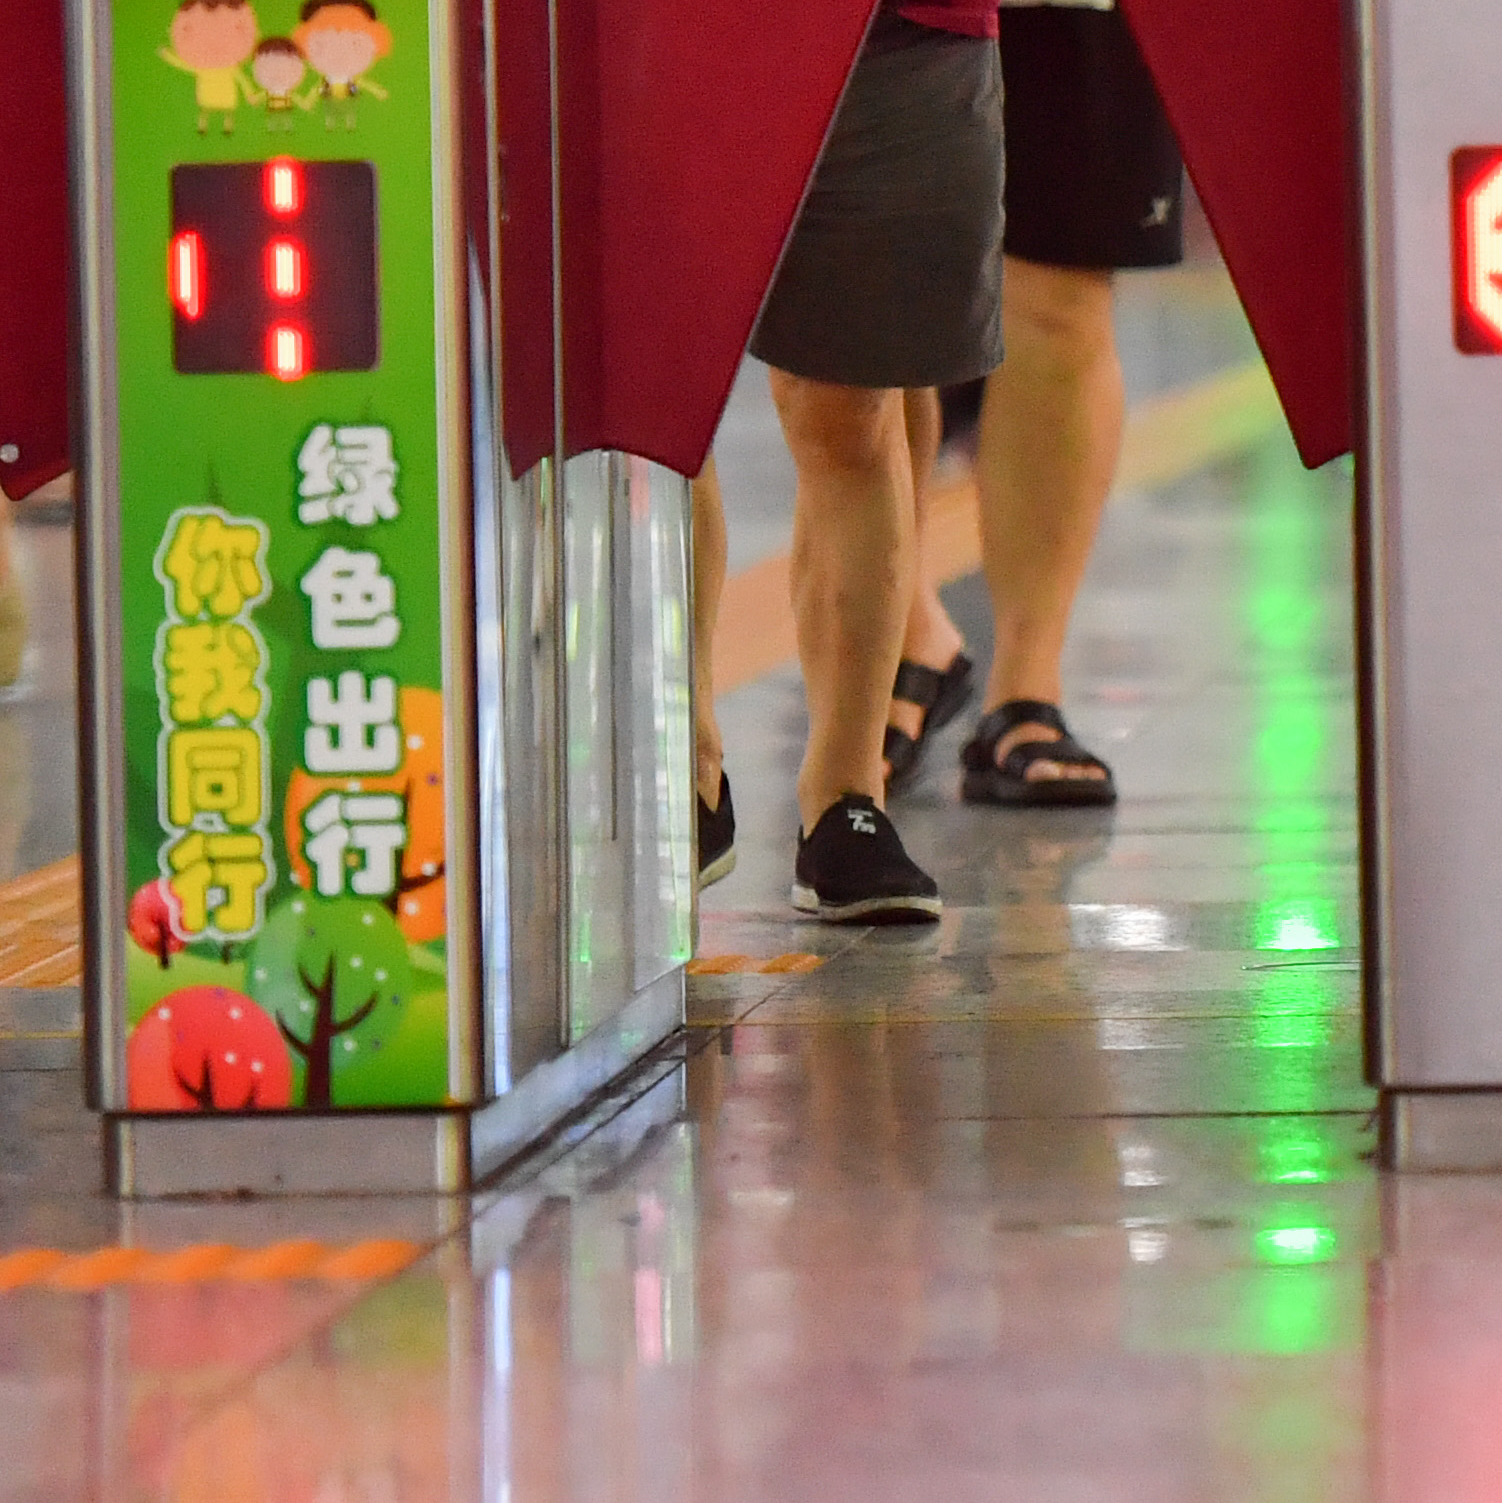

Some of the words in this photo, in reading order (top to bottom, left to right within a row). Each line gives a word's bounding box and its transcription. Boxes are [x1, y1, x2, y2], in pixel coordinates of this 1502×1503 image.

[158, 509, 272, 938] 你我同行
[299, 424, 406, 898] 绿色出行
